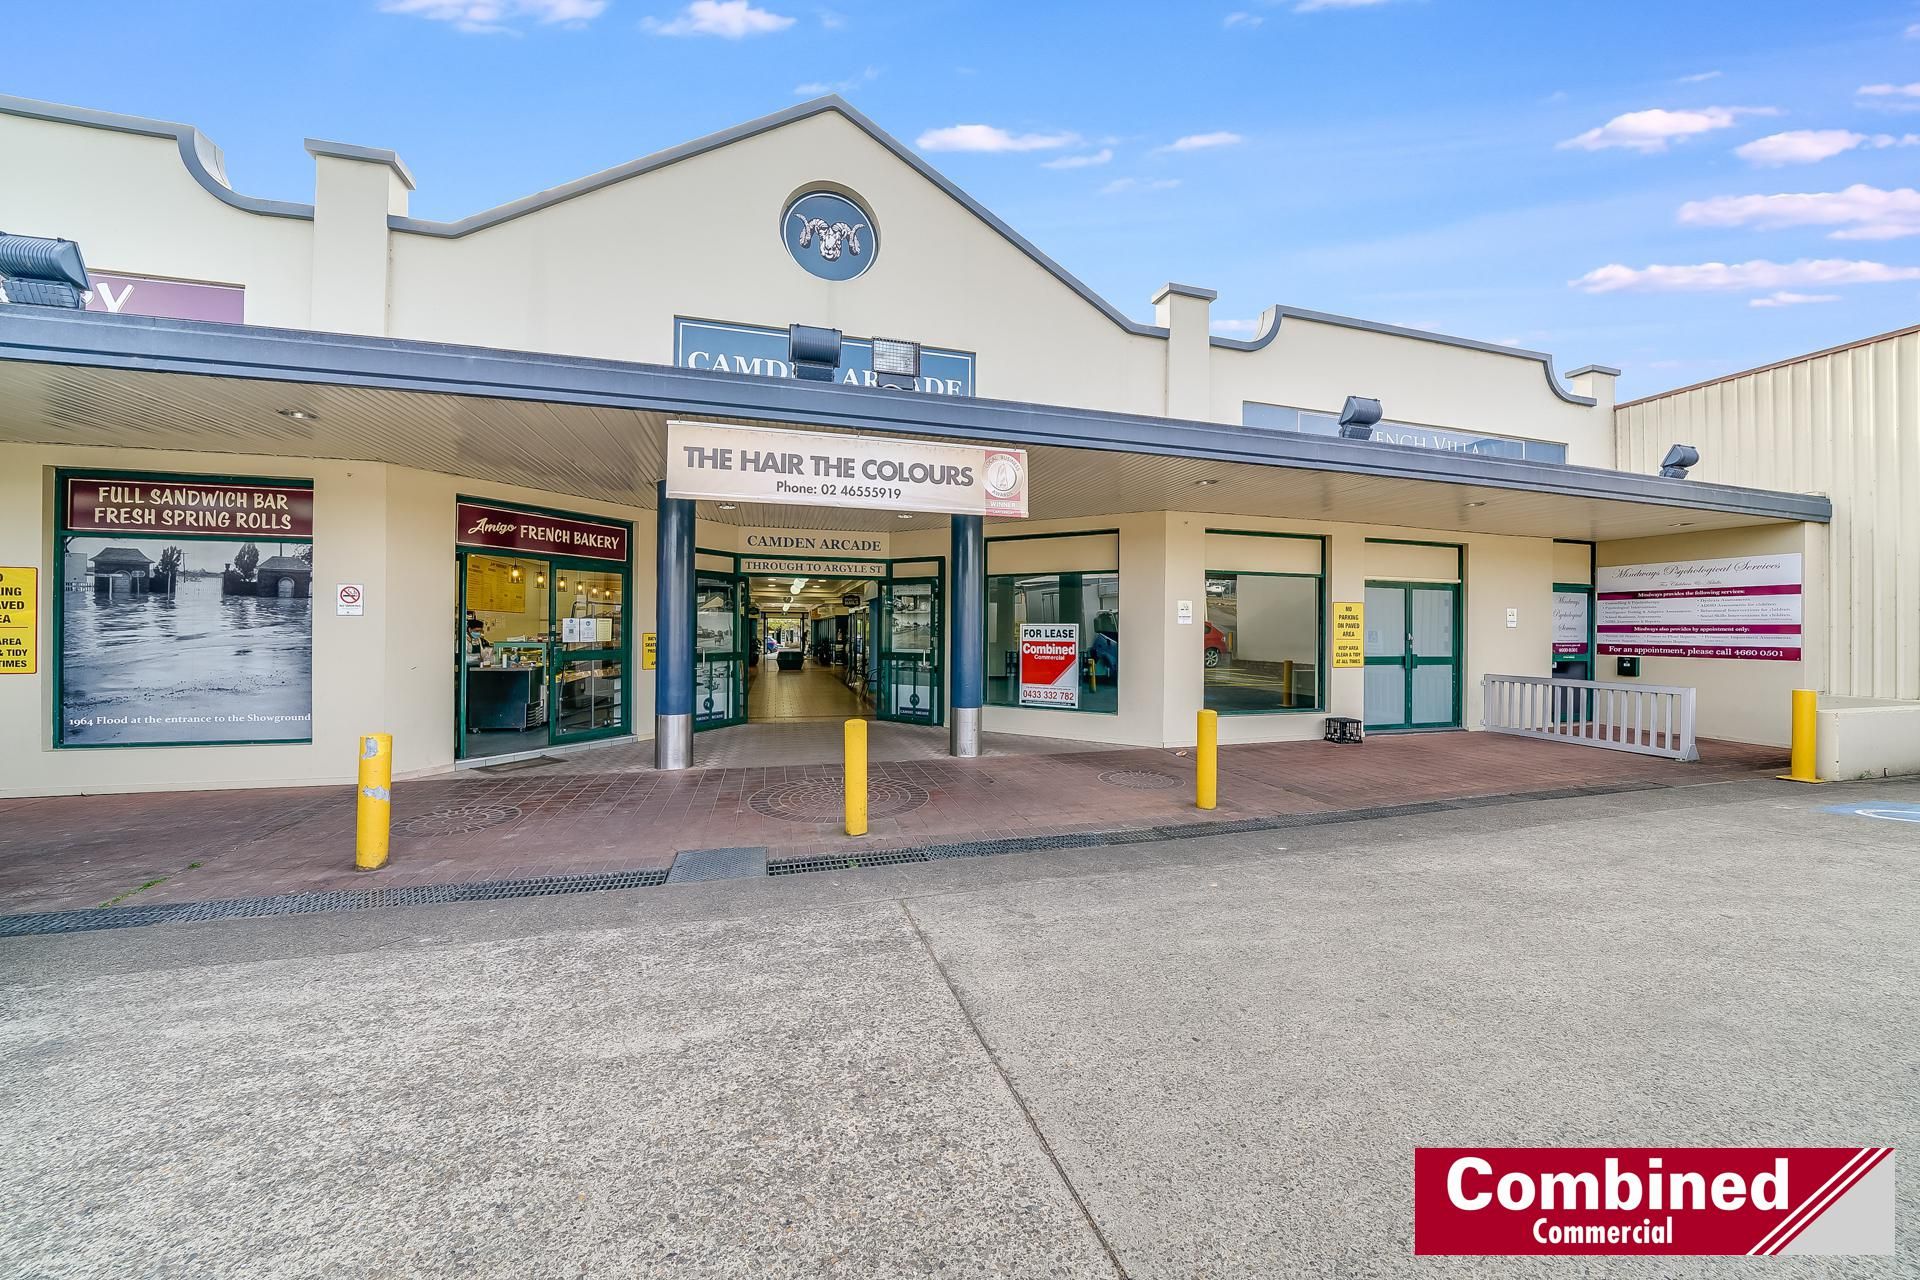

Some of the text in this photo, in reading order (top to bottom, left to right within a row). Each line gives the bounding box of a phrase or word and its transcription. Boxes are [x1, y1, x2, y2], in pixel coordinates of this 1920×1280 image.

[688, 351, 962, 397] CAMD ARDE
[1376, 432, 1426, 448] ENCH
[683, 446, 974, 487] THE HAIR THE COLOURS
[776, 480, 901, 499] Phone: 02 46555919
[98, 486, 289, 510] FULL SANDWICH BAR
[94, 507, 292, 530] FRESH SPRING ROLLS
[468, 517, 620, 550] Amigo FRENCH BAKERY
[747, 535, 881, 552] CAMDEN ARCADE
[745, 561, 882, 574] THROUGH TO ARGYLE ST
[1612, 560, 1781, 580] Mindways Psychological Services
[0, 600, 25, 610] VED
[1024, 629, 1074, 638] FOR LEASE
[1023, 643, 1075, 655] Combined
[1636, 646, 1686, 655] appointment,
[1687, 647, 1714, 656] please
[1715, 648, 1732, 656] call
[1023, 690, 1042, 698] 0433
[1043, 691, 1058, 699] 332
[69, 716, 94, 727] 1964
[96, 716, 128, 725] Flood
[144, 715, 162, 724] the
[228, 714, 245, 722] the
[247, 713, 311, 724] Showground
